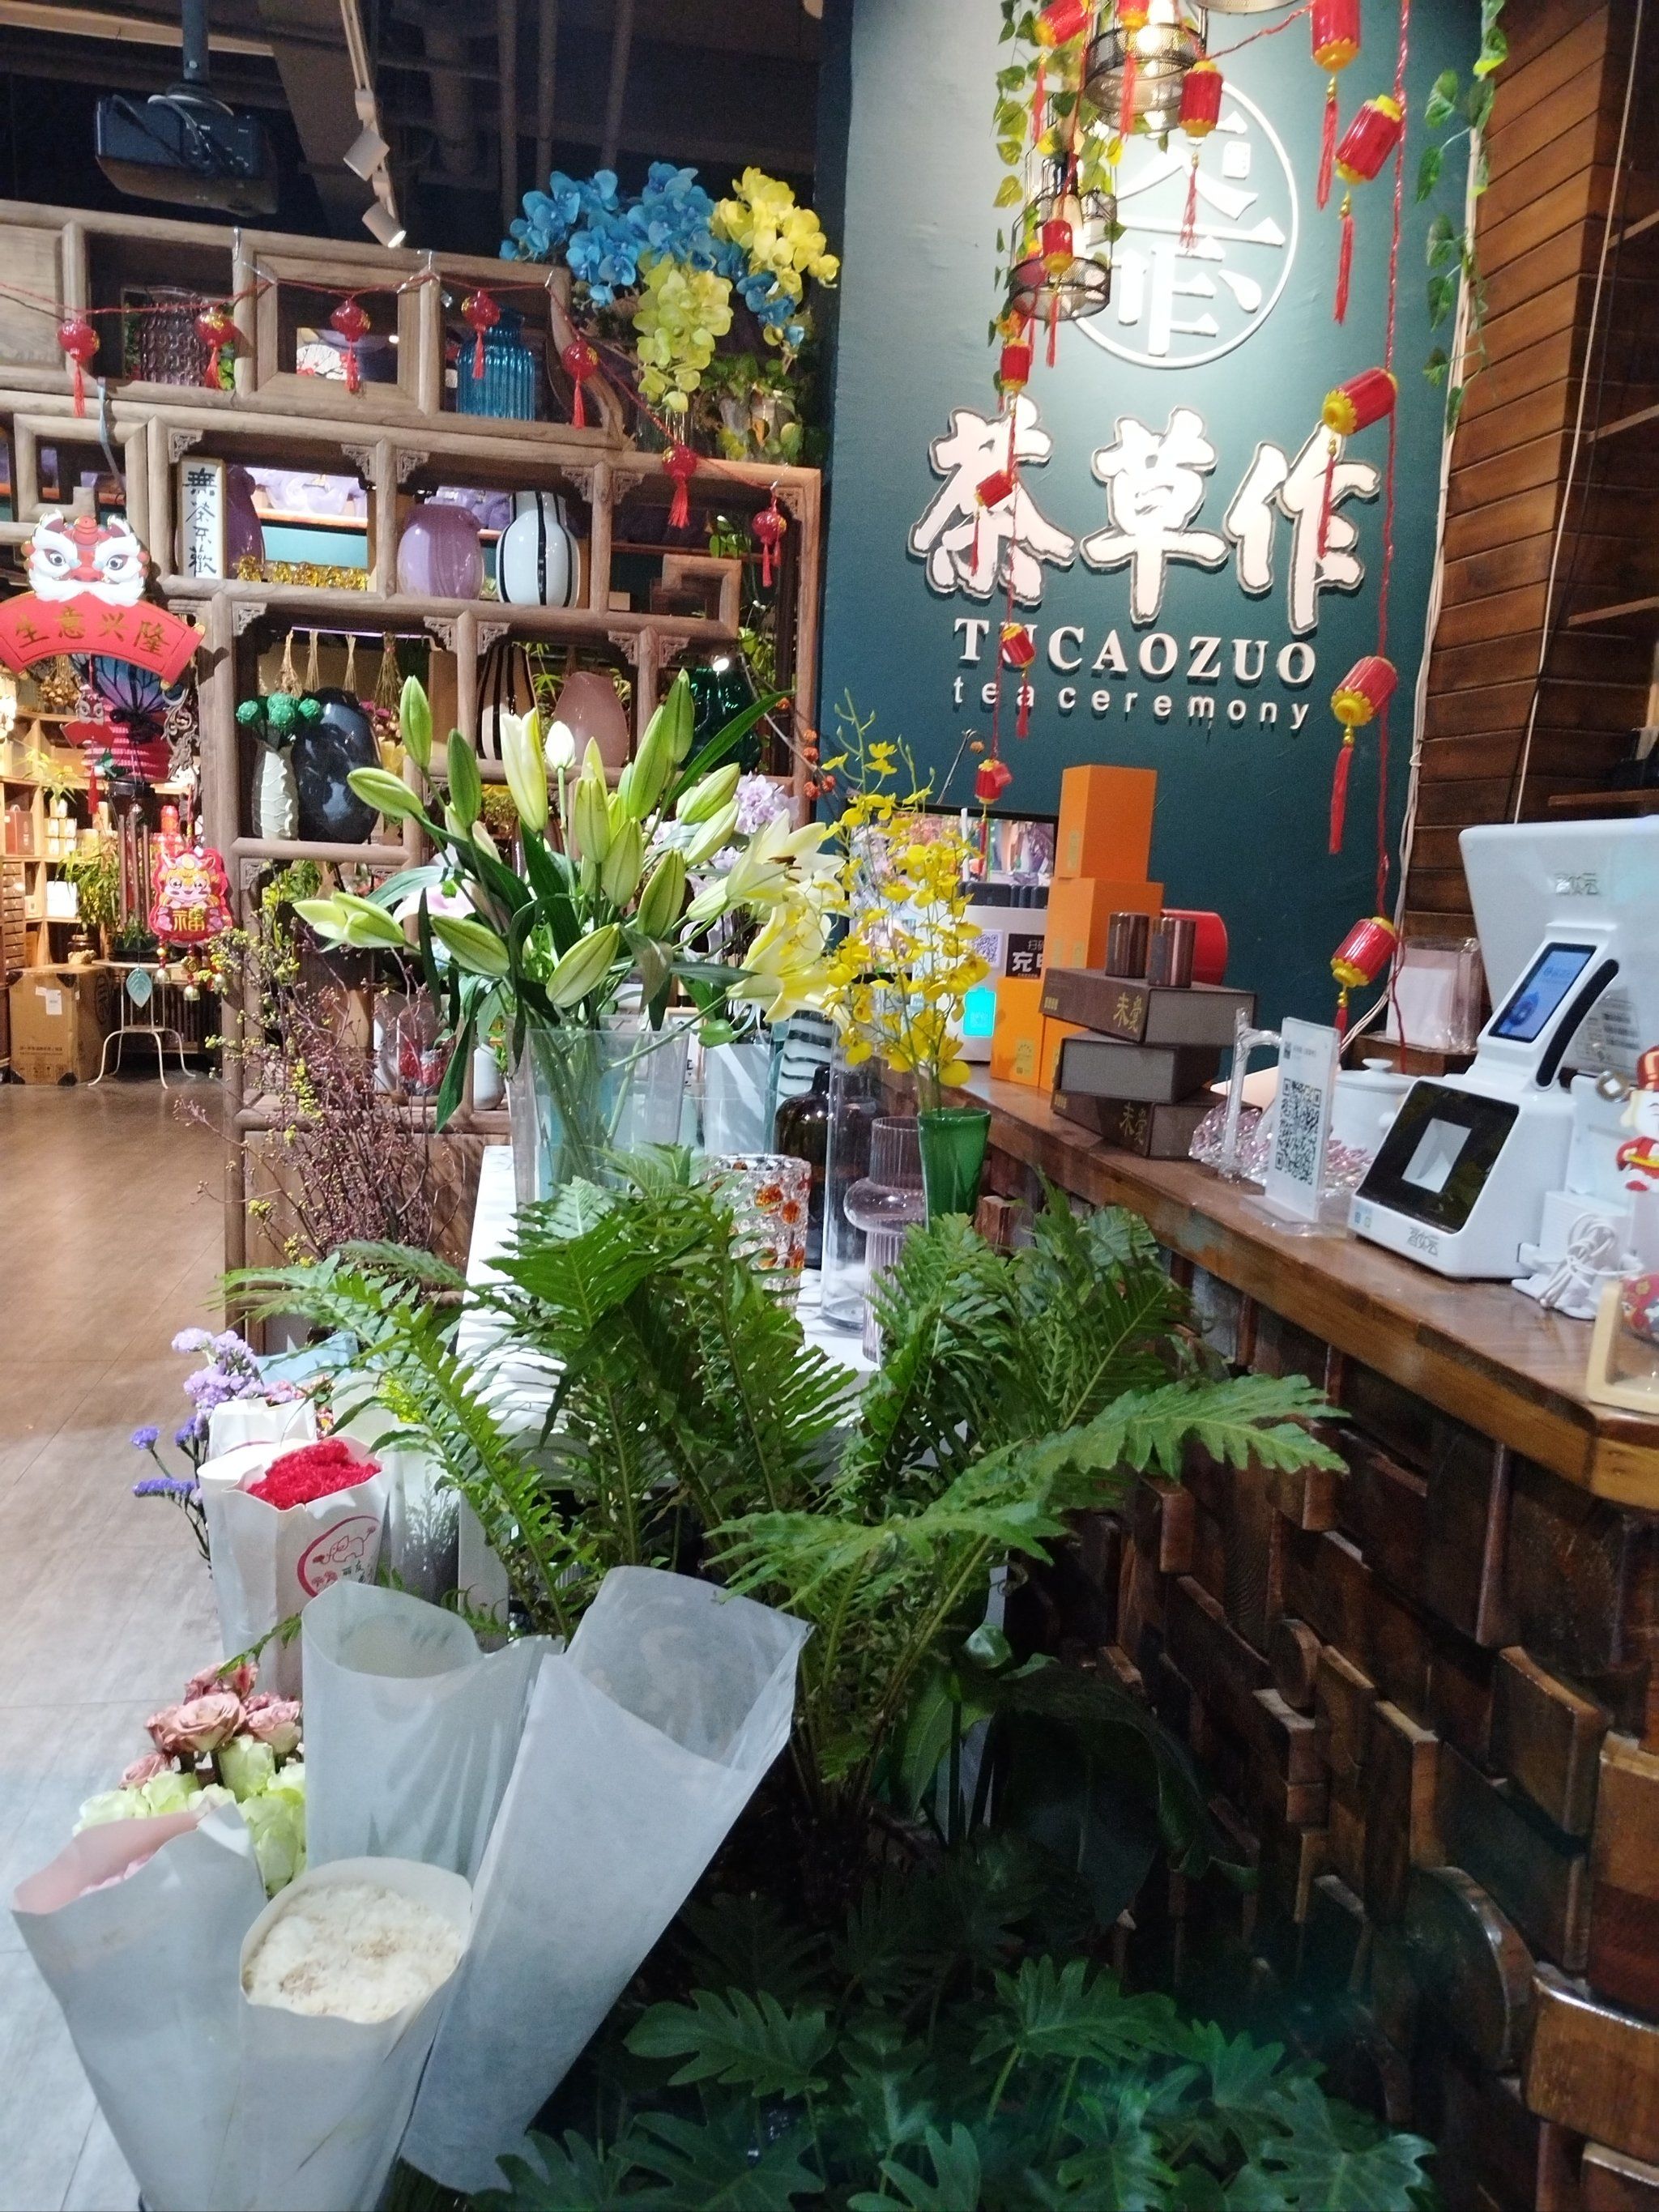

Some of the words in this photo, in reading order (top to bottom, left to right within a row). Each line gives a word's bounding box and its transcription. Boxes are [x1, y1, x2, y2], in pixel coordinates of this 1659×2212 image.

[15, 606, 170, 656] 生意兴隆
[953, 676, 1034, 707] tea
[1058, 686, 1310, 730] ceremony
[172, 908, 205, 931] 福
